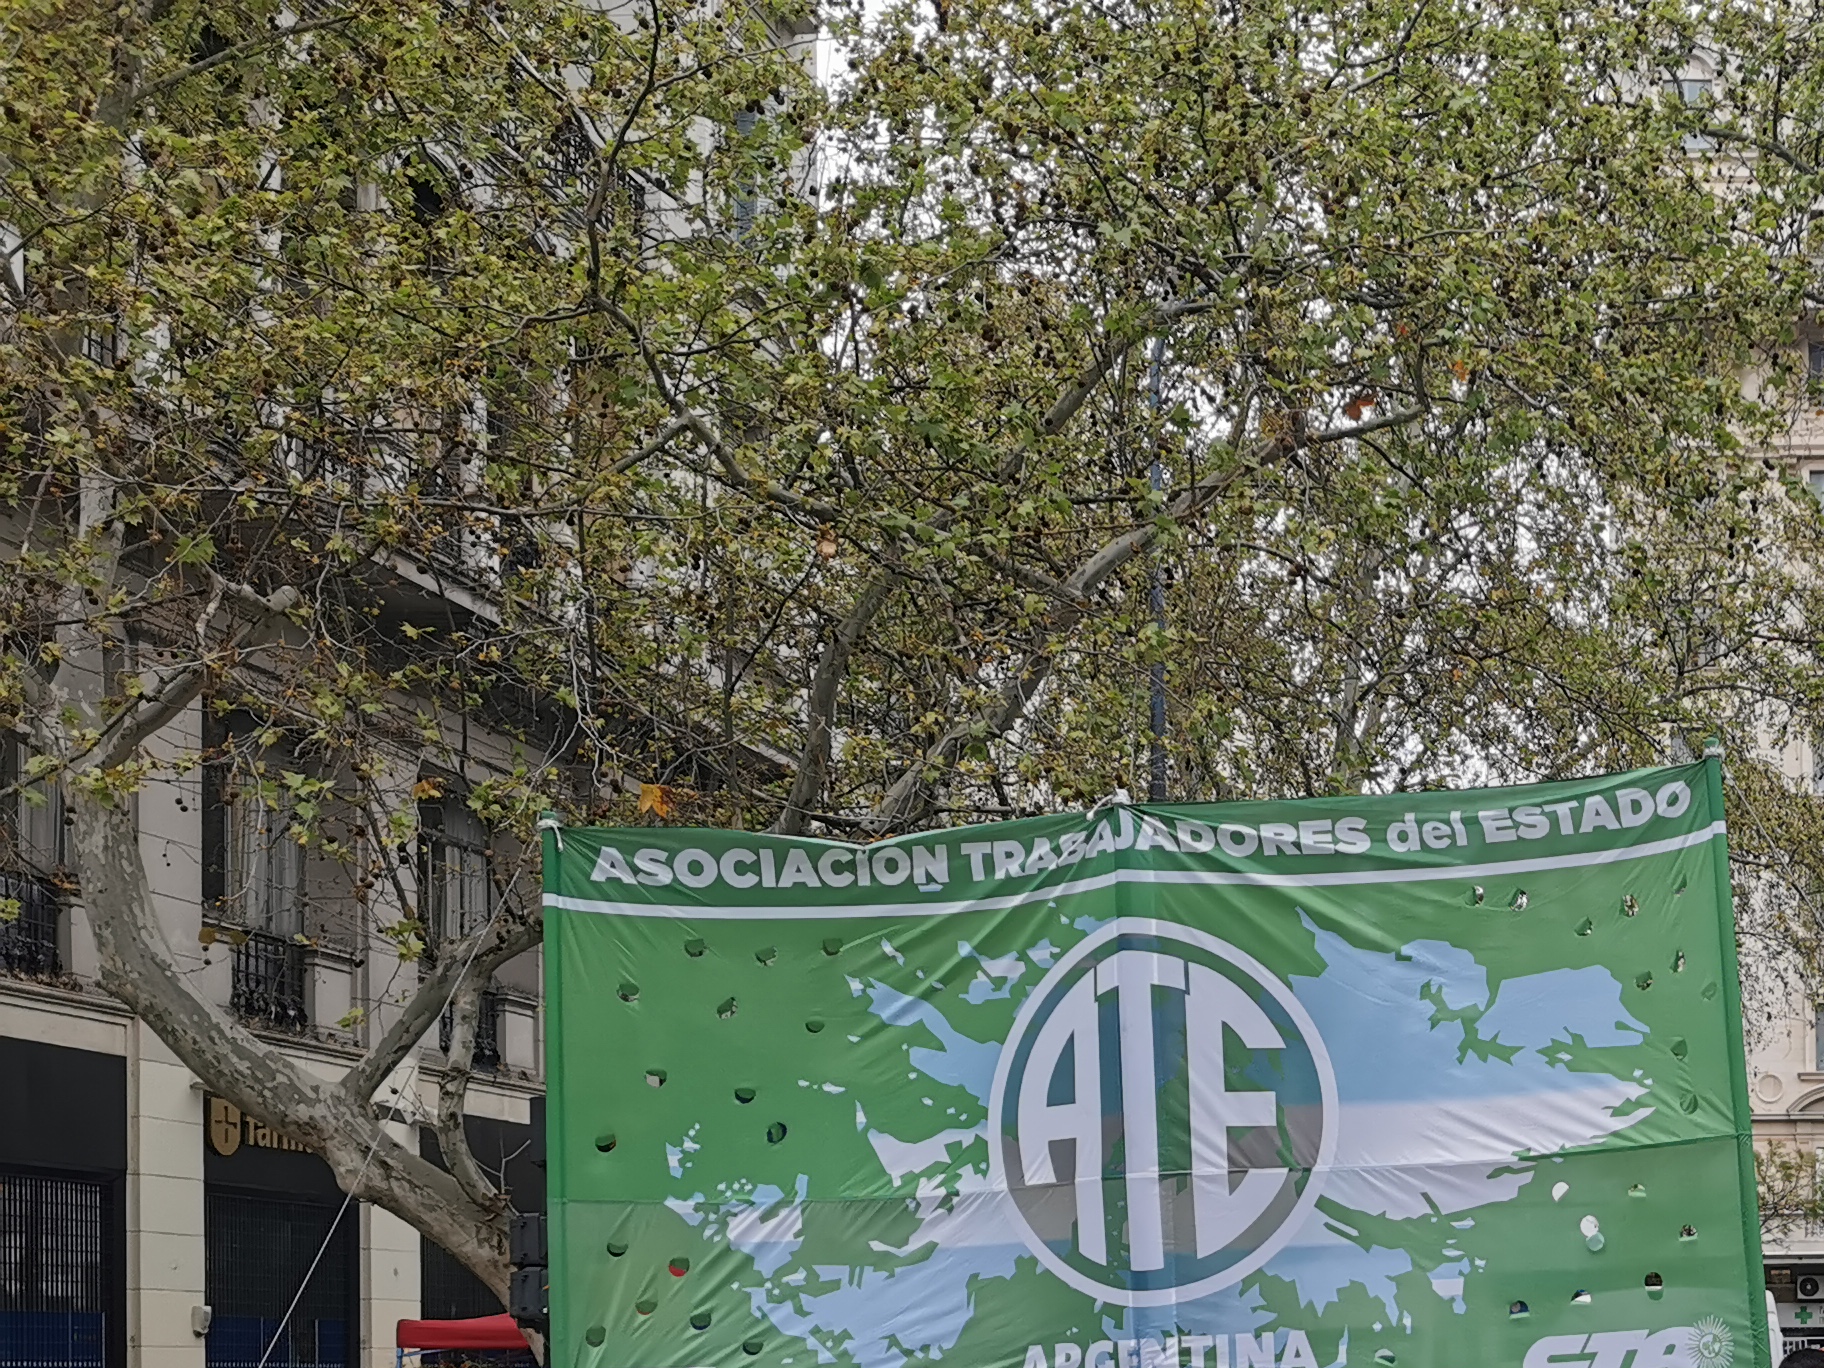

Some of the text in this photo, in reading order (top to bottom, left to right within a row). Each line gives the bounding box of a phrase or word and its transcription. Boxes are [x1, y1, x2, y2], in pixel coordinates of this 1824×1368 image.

[591, 780, 1692, 887] ASOCIACION TRABAJADORES del ESTADO
[1018, 949, 1290, 1272] ATE
